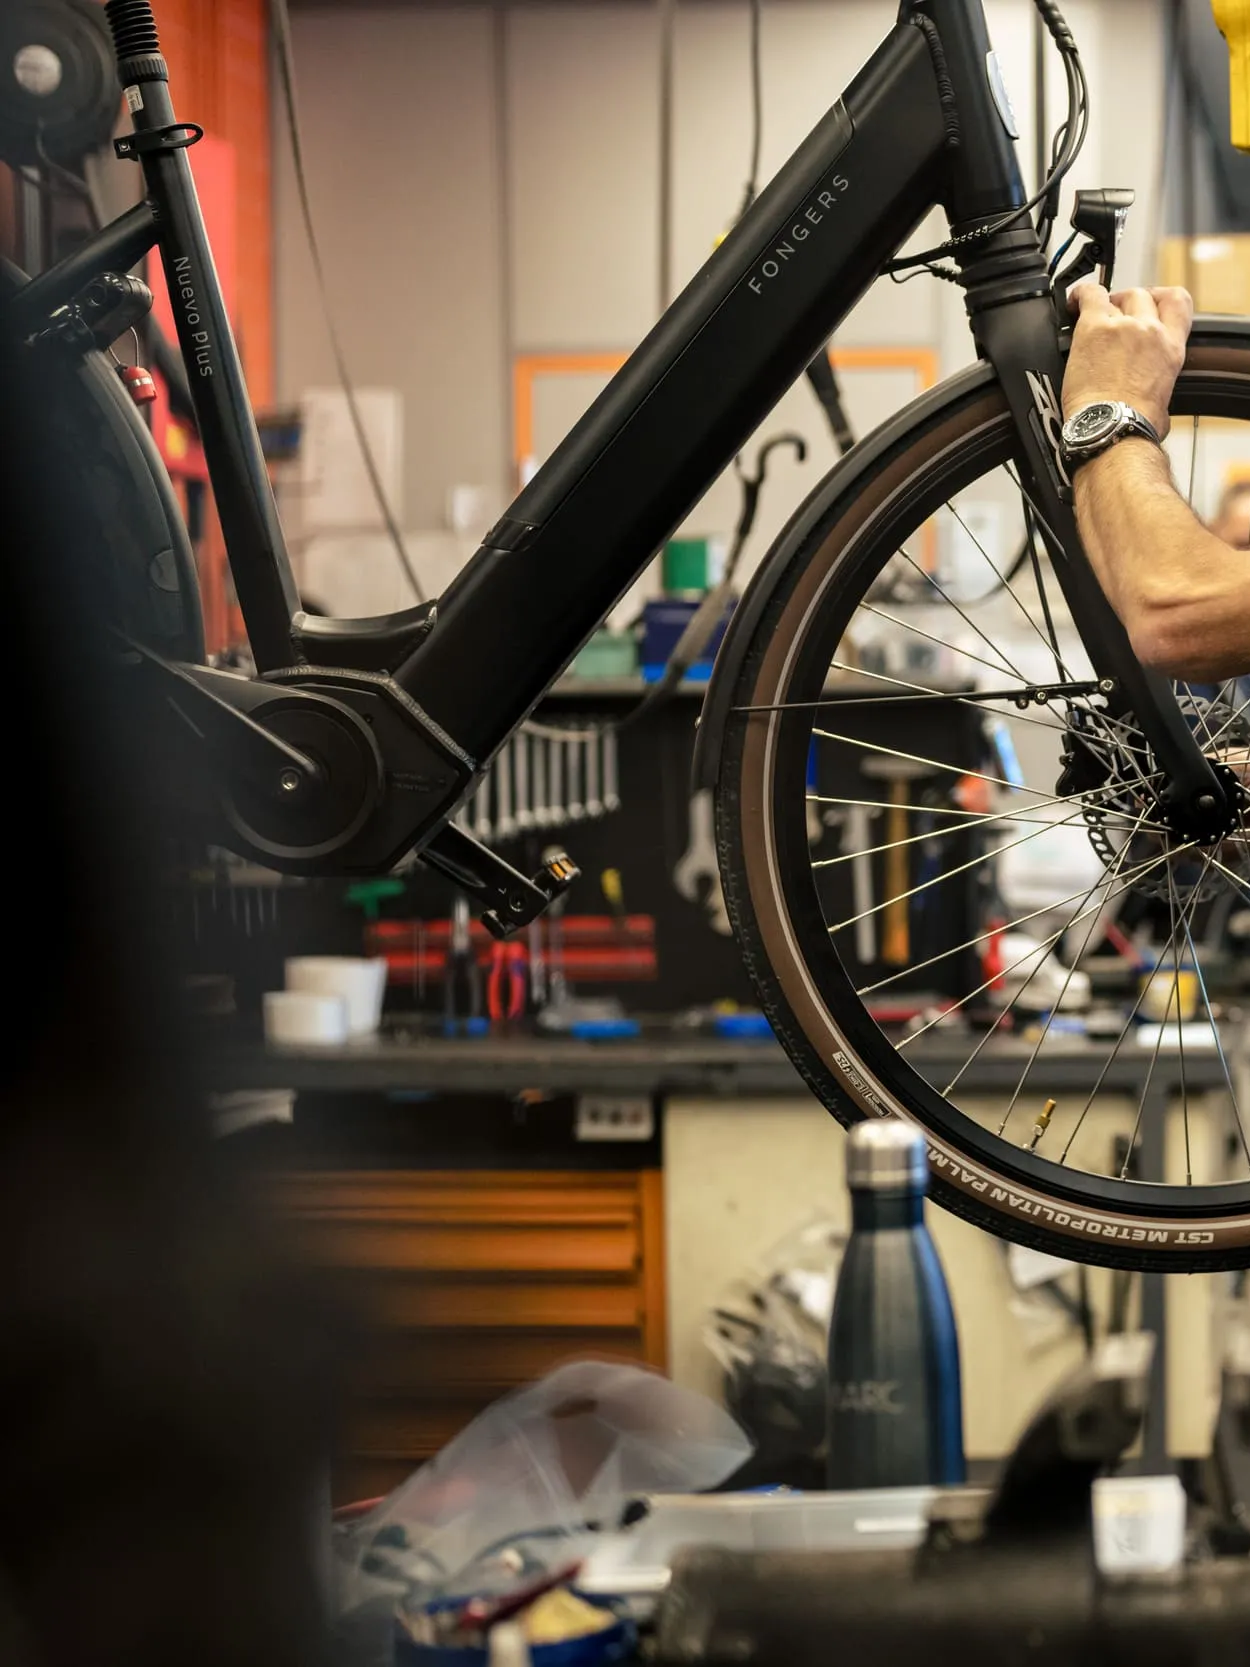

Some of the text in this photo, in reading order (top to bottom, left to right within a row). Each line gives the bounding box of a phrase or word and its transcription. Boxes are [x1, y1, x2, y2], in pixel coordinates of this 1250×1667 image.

[747, 174, 850, 295] FONGERS
[173, 256, 200, 325] Nuevo
[990, 1187, 1168, 1244] METROPOLITAN
[1173, 1231, 1215, 1244] CST
